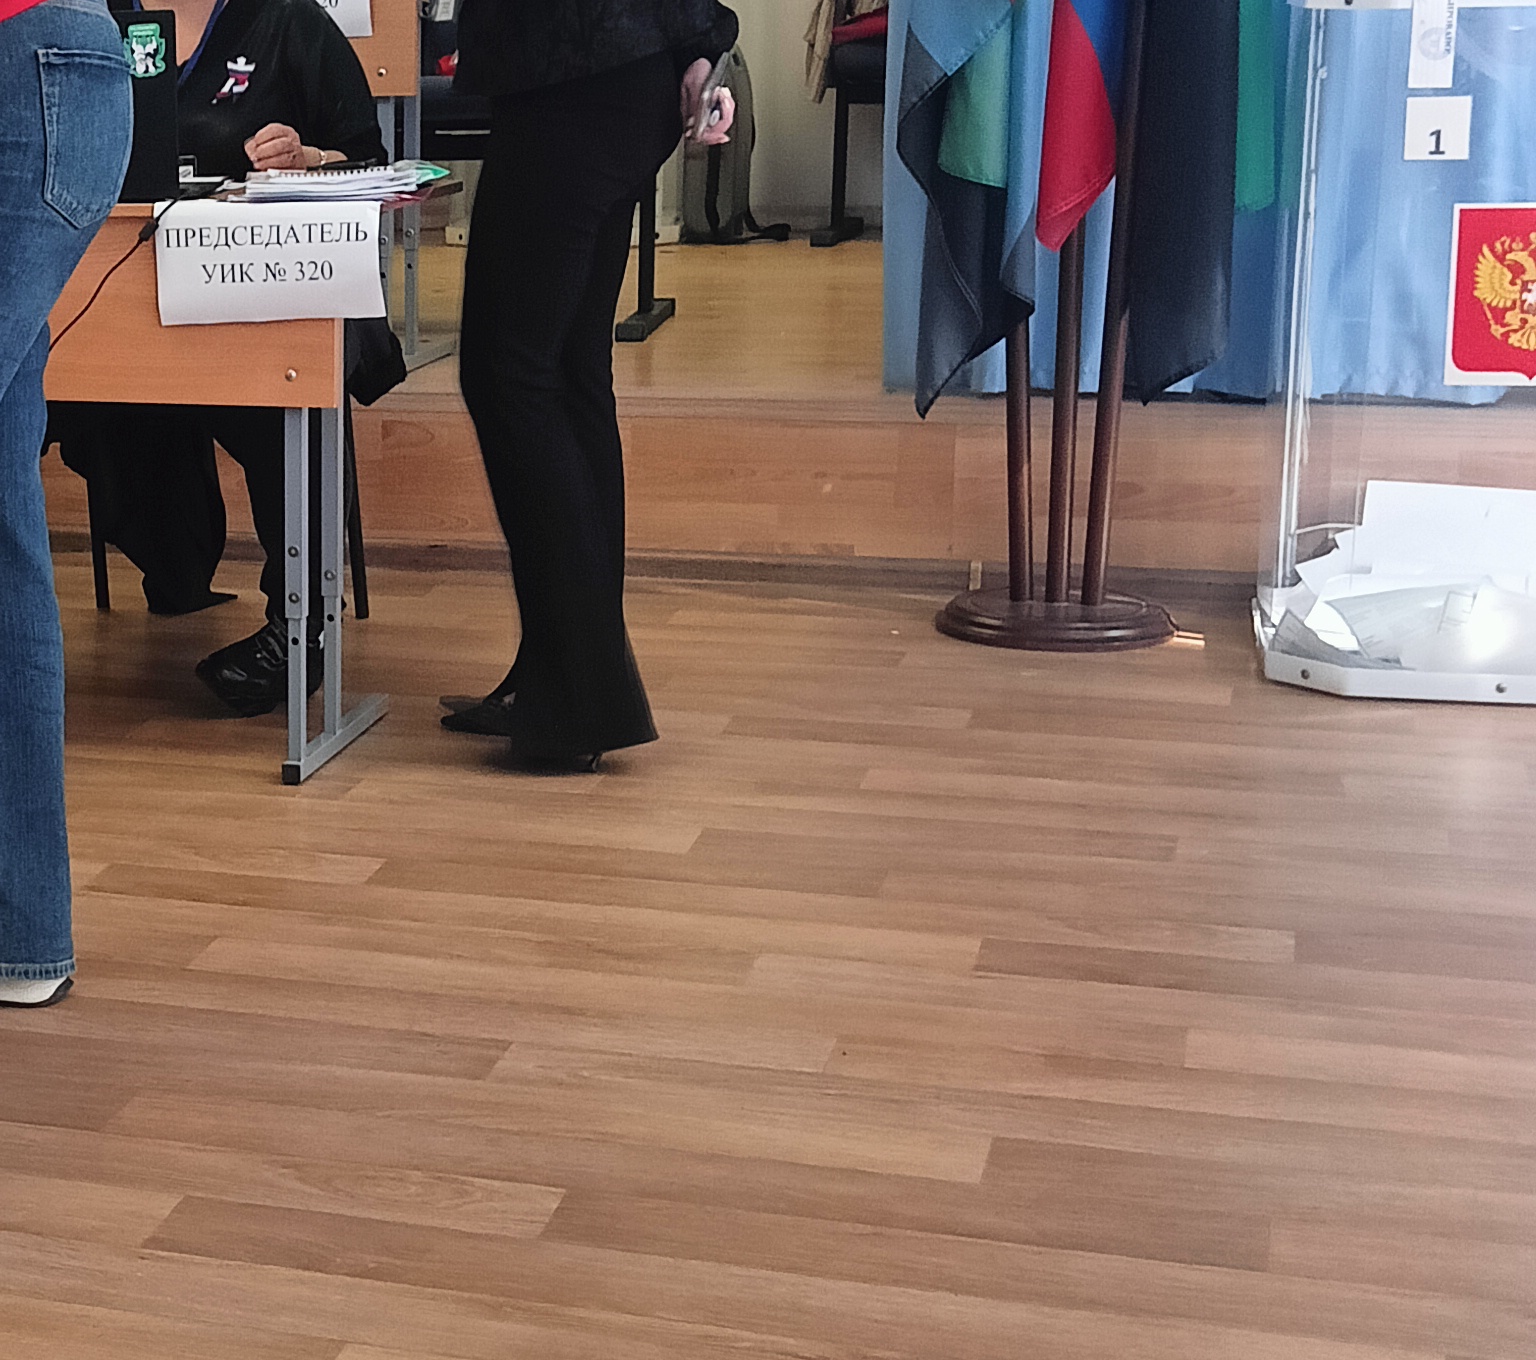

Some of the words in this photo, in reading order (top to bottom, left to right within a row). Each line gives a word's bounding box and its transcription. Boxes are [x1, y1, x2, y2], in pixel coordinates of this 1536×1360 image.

[1428, 128, 1446, 156] 1
[164, 221, 369, 251] ПРЕДСЕДАТЕЛЬ
[201, 262, 255, 285] УИК
[262, 261, 287, 283] №
[295, 260, 334, 282] 320
